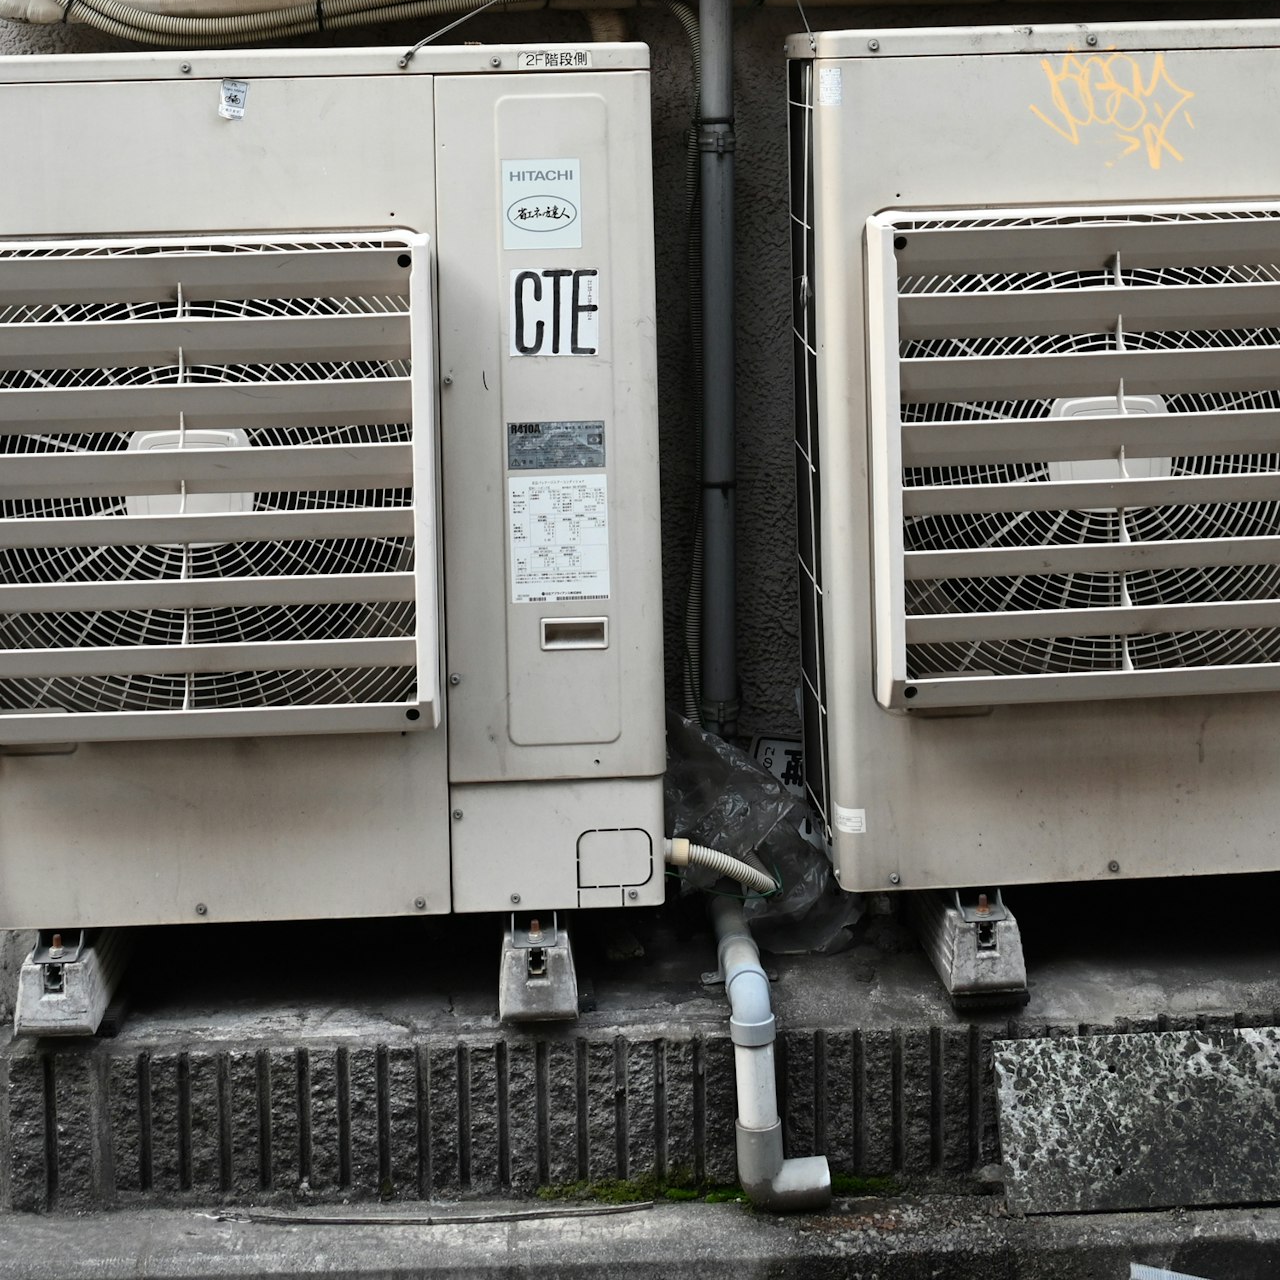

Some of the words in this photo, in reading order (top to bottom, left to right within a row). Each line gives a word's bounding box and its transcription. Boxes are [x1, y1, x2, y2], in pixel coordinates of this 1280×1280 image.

[525, 51, 588, 67] 2F階段側
[509, 170, 573, 182] HITACHI
[514, 205, 570, 221] 省エネの達人
[514, 269, 598, 355] CTE
[510, 423, 541, 434] R410A
